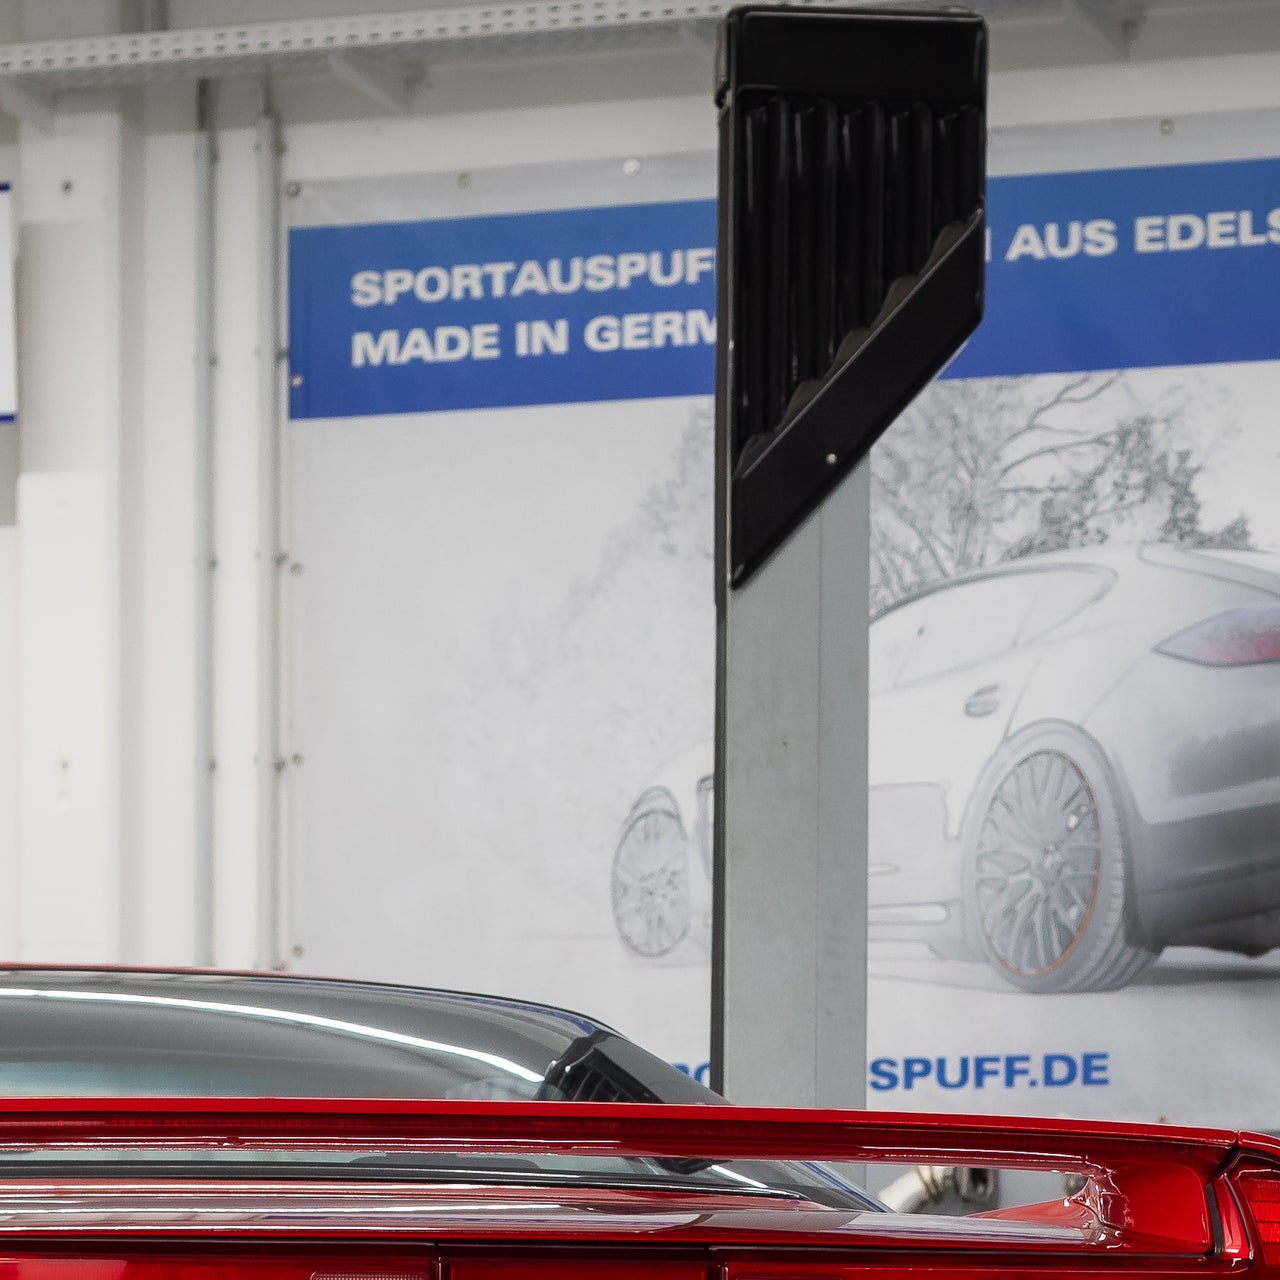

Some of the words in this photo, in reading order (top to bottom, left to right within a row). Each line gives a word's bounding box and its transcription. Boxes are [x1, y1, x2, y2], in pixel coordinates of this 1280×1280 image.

[351, 246, 715, 307] SPORTAUSPUF
[1005, 220, 1117, 261] AUS
[352, 323, 501, 368] MADE
[516, 319, 569, 356] IN
[869, 1052, 1111, 1091] SPUFF.DE
